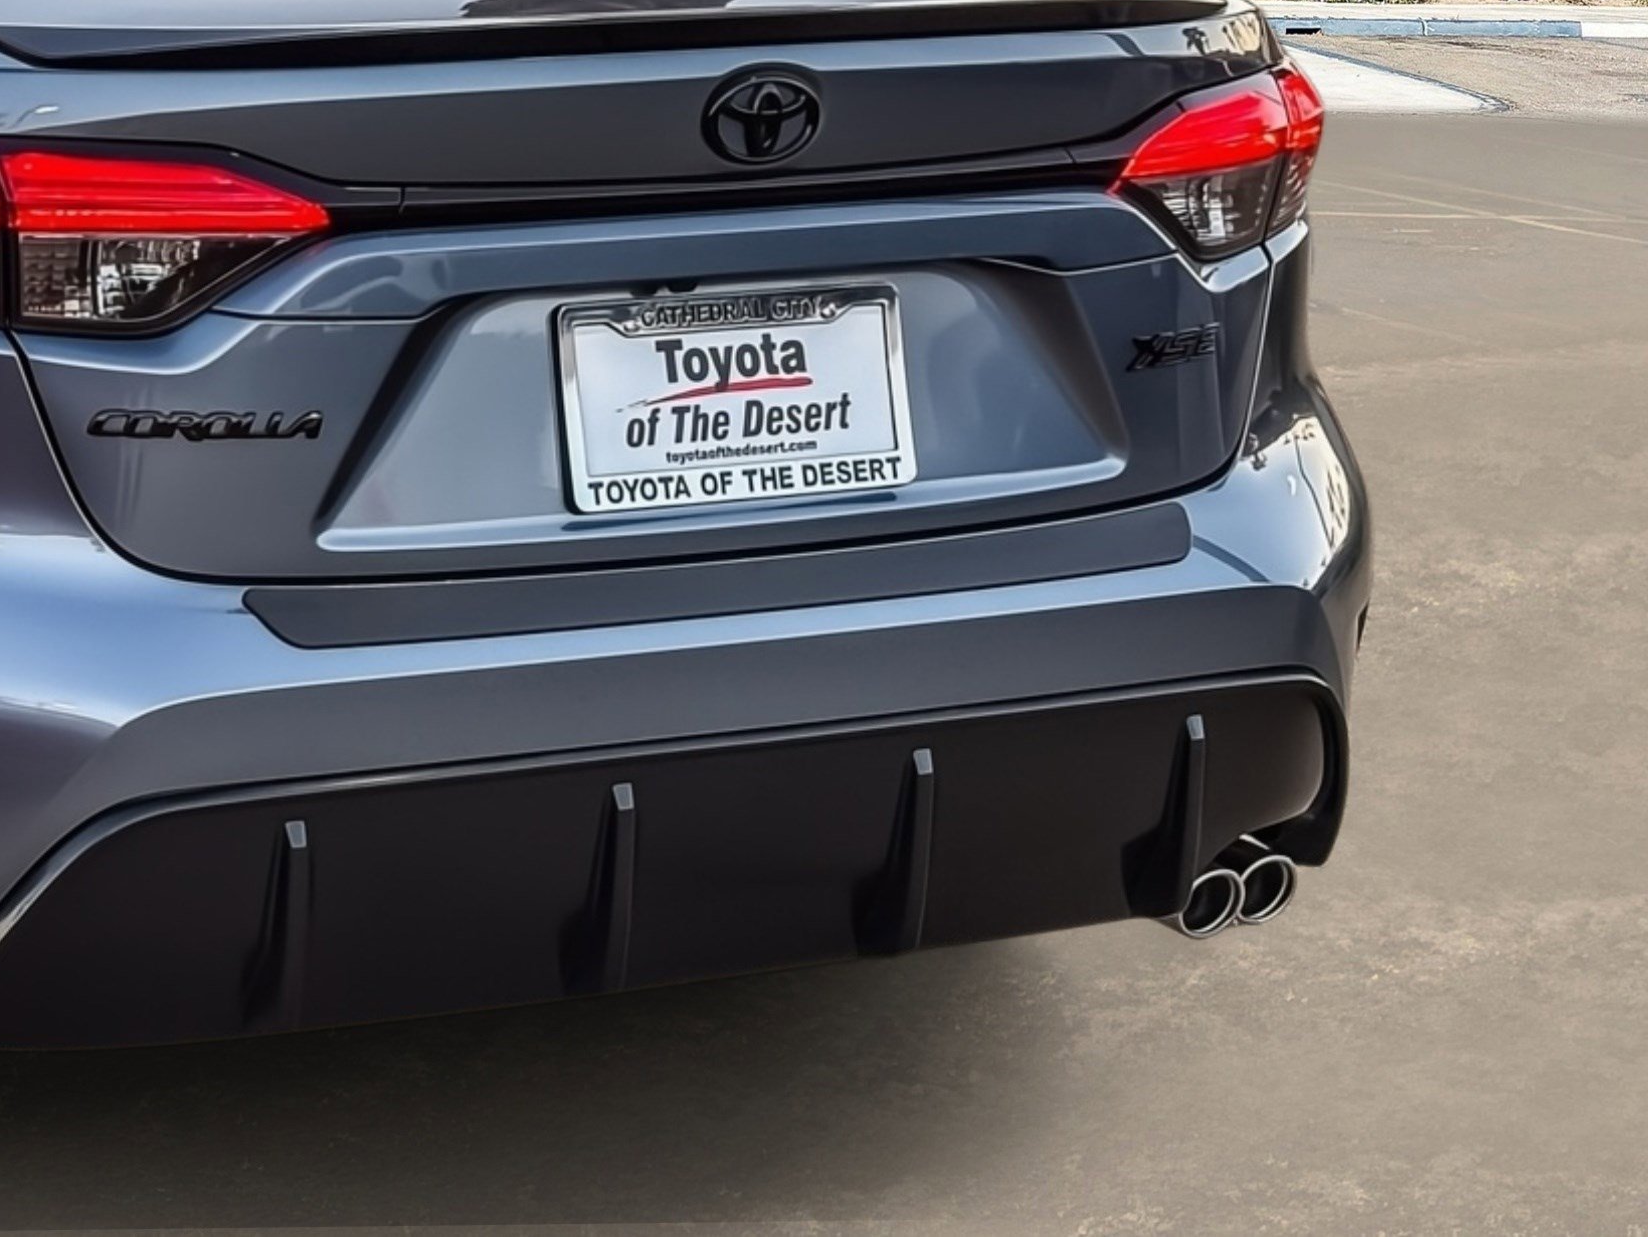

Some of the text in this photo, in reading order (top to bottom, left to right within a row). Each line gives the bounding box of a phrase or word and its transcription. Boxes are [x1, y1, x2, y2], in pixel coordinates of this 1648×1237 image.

[640, 297, 767, 328] CATHEDRAL
[655, 333, 807, 391] Toyota
[86, 408, 323, 442] COROLLA
[626, 392, 851, 448] of The Desert
[666, 440, 818, 465] toyotaofthedesert.com
[587, 456, 901, 506] TOYOTA OF THE DESERT
